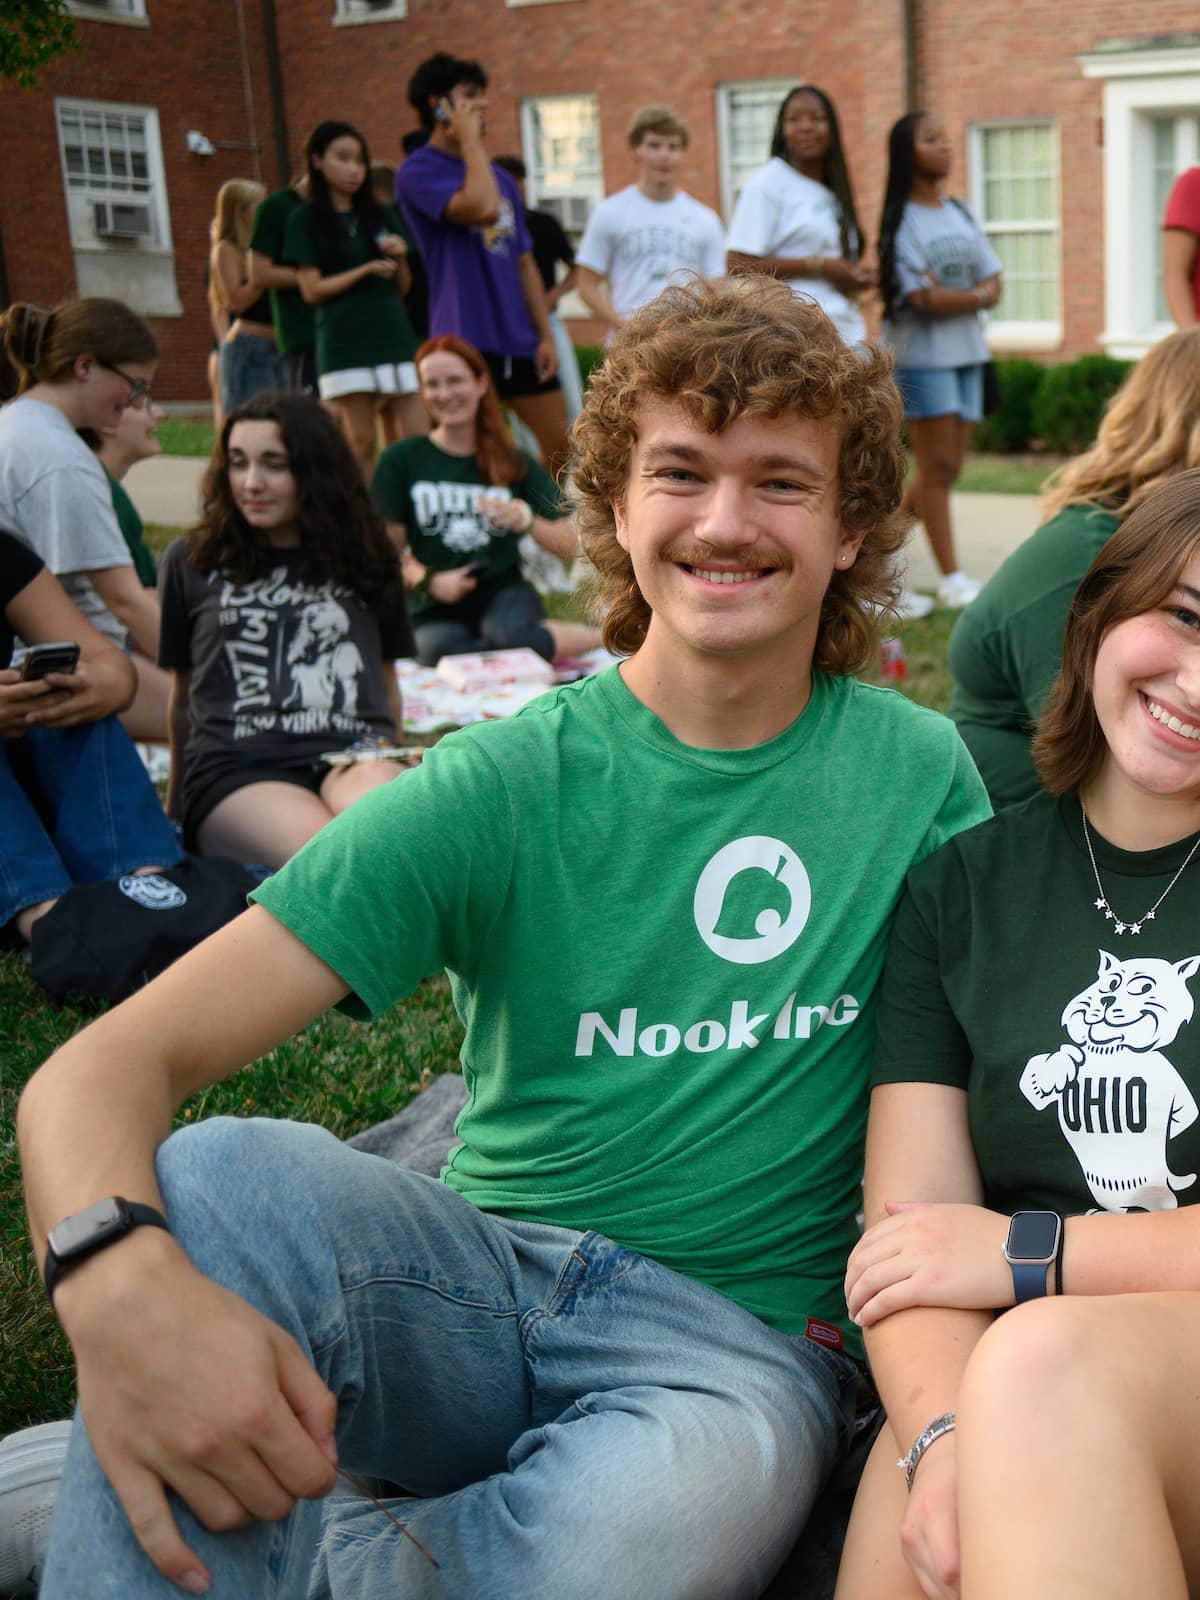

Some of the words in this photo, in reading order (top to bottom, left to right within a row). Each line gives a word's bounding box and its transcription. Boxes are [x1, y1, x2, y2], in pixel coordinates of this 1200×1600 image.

[411, 480, 512, 536] OHI
[281, 710, 331, 734] YORK
[575, 1000, 770, 1057] Nook
[773, 991, 860, 1040] Inc
[1062, 1076, 1147, 1134] OHIO
